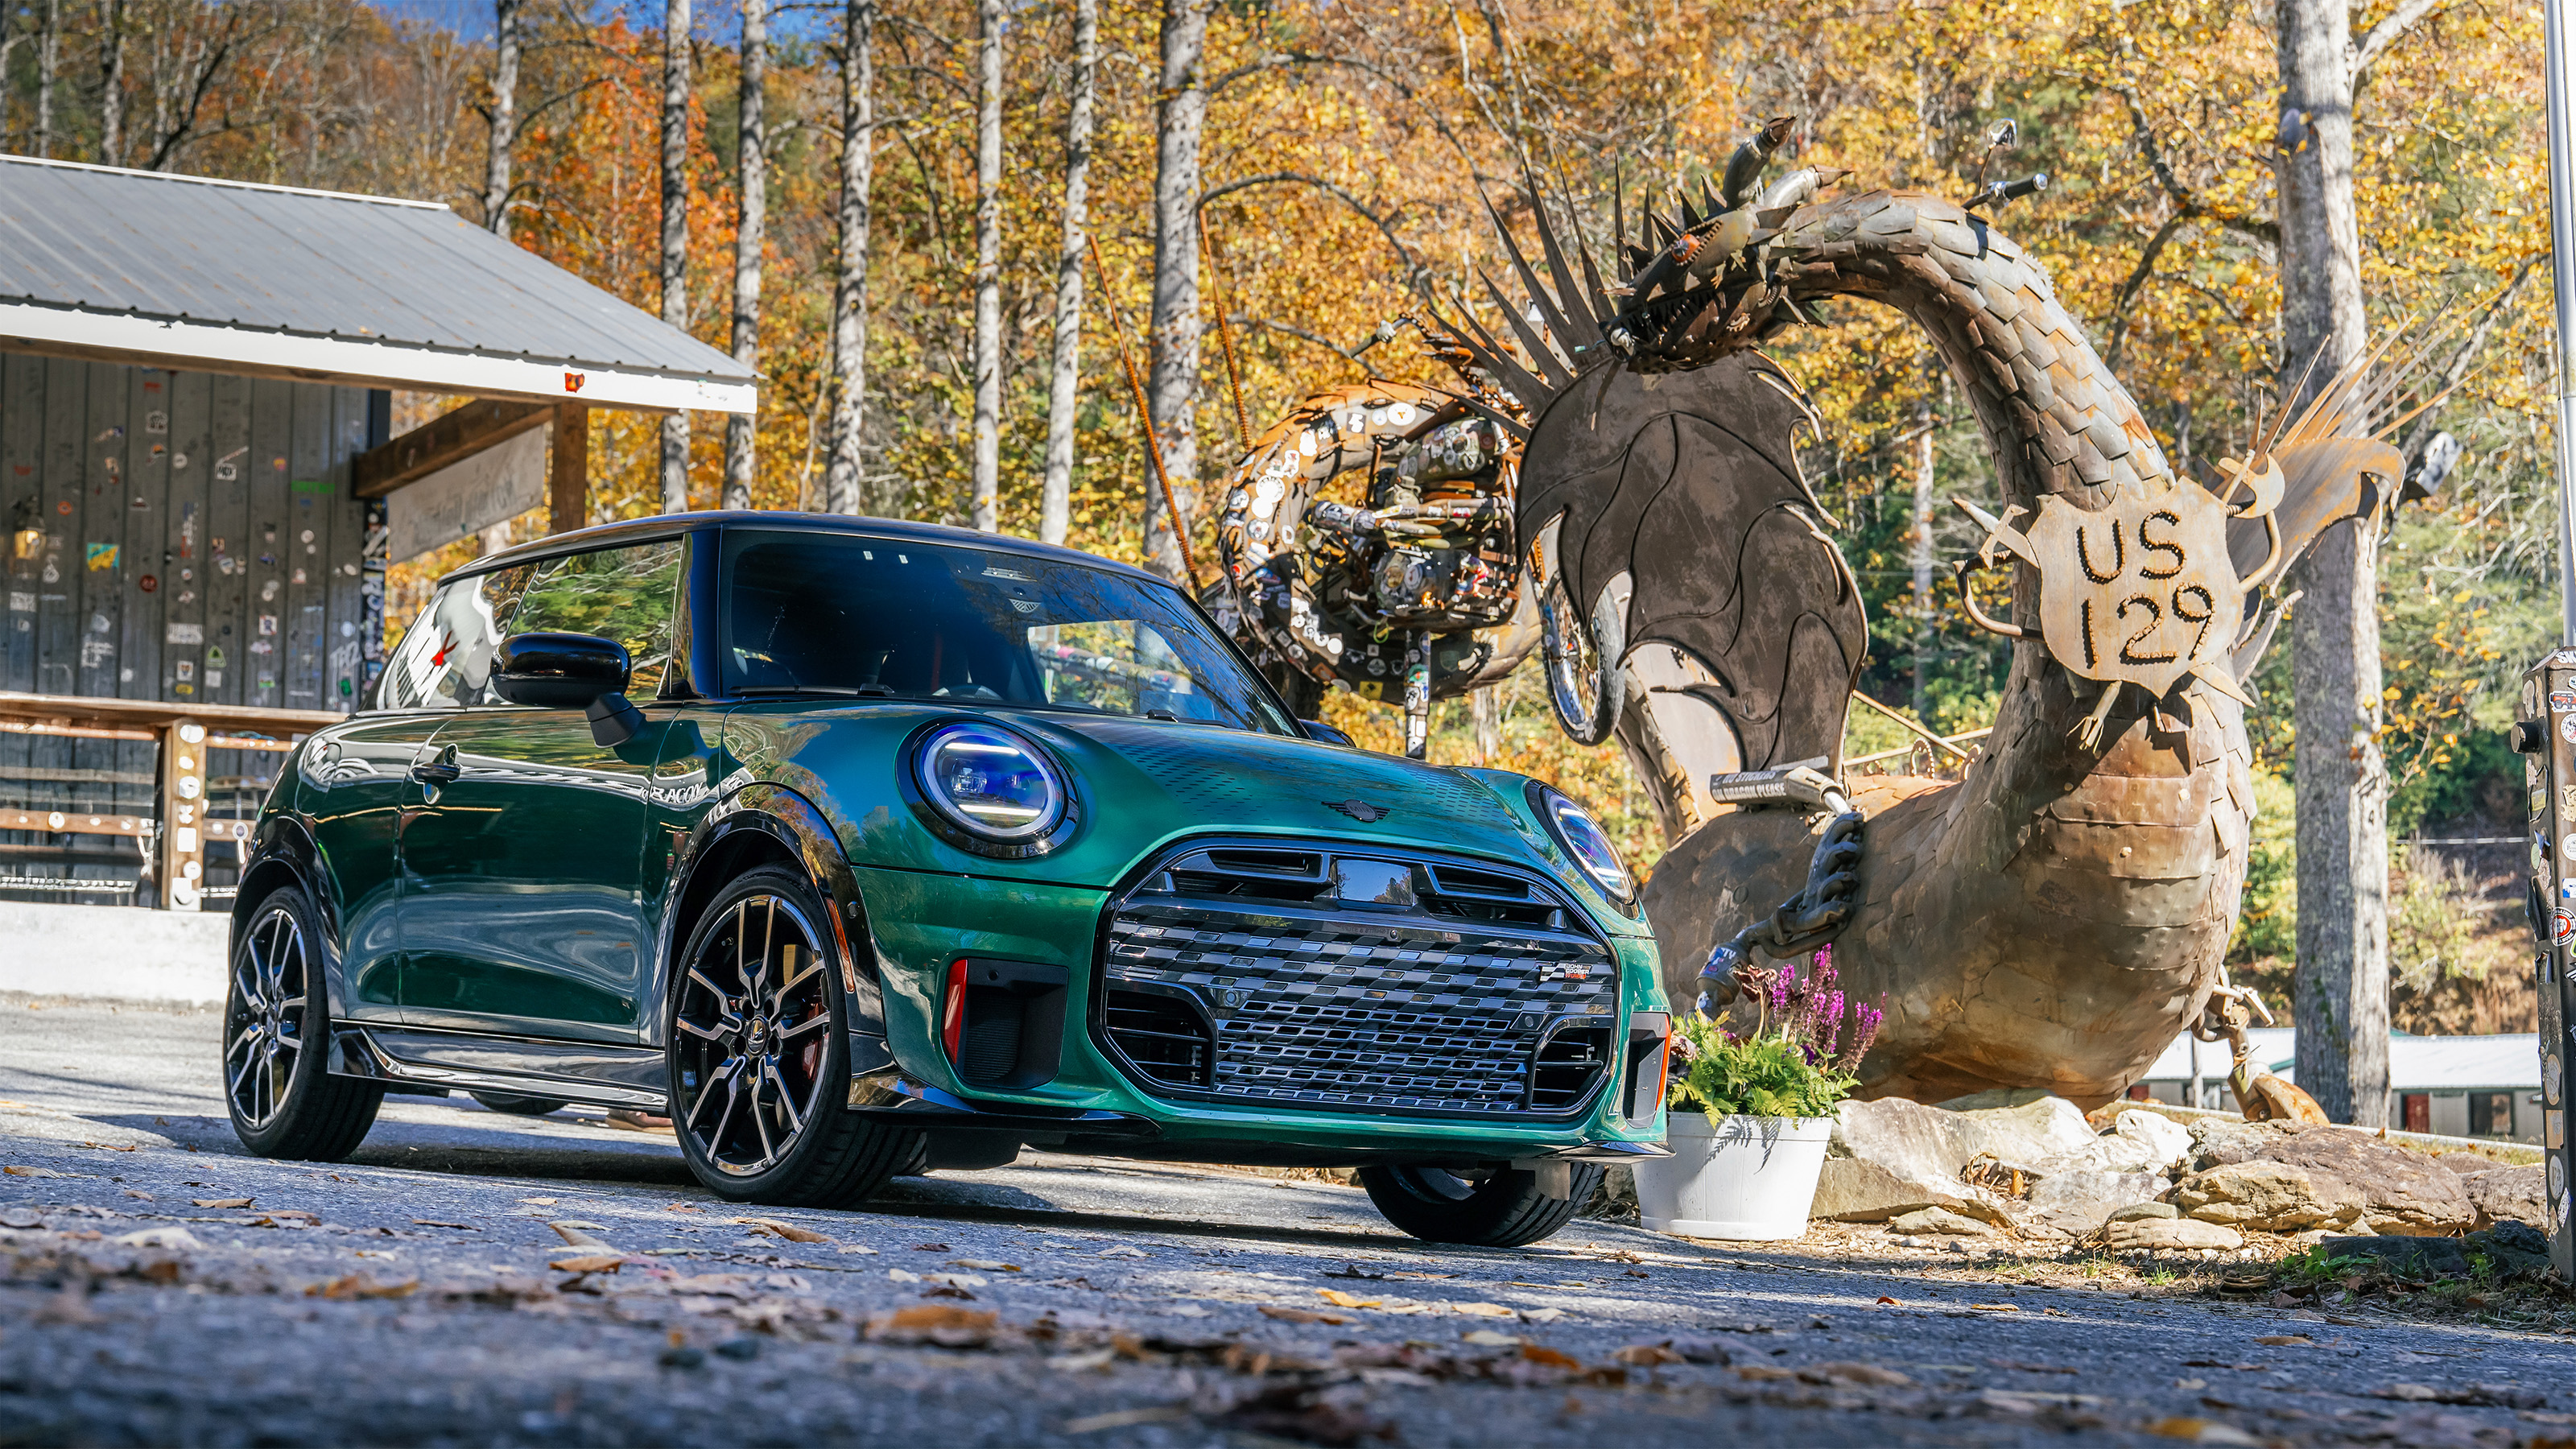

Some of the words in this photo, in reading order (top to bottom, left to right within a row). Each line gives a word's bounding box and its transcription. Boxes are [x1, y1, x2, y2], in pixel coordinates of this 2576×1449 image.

[2077, 508, 2186, 584] US
[2083, 581, 2215, 668] 129
[1723, 774, 1736, 783] NO
[1736, 770, 1776, 782] STICKERS
[1711, 789, 1726, 801] ON
[1724, 786, 1758, 800] DRAGON
[1757, 782, 1786, 798] PLEASE
[1349, 806, 1373, 814] MINI
